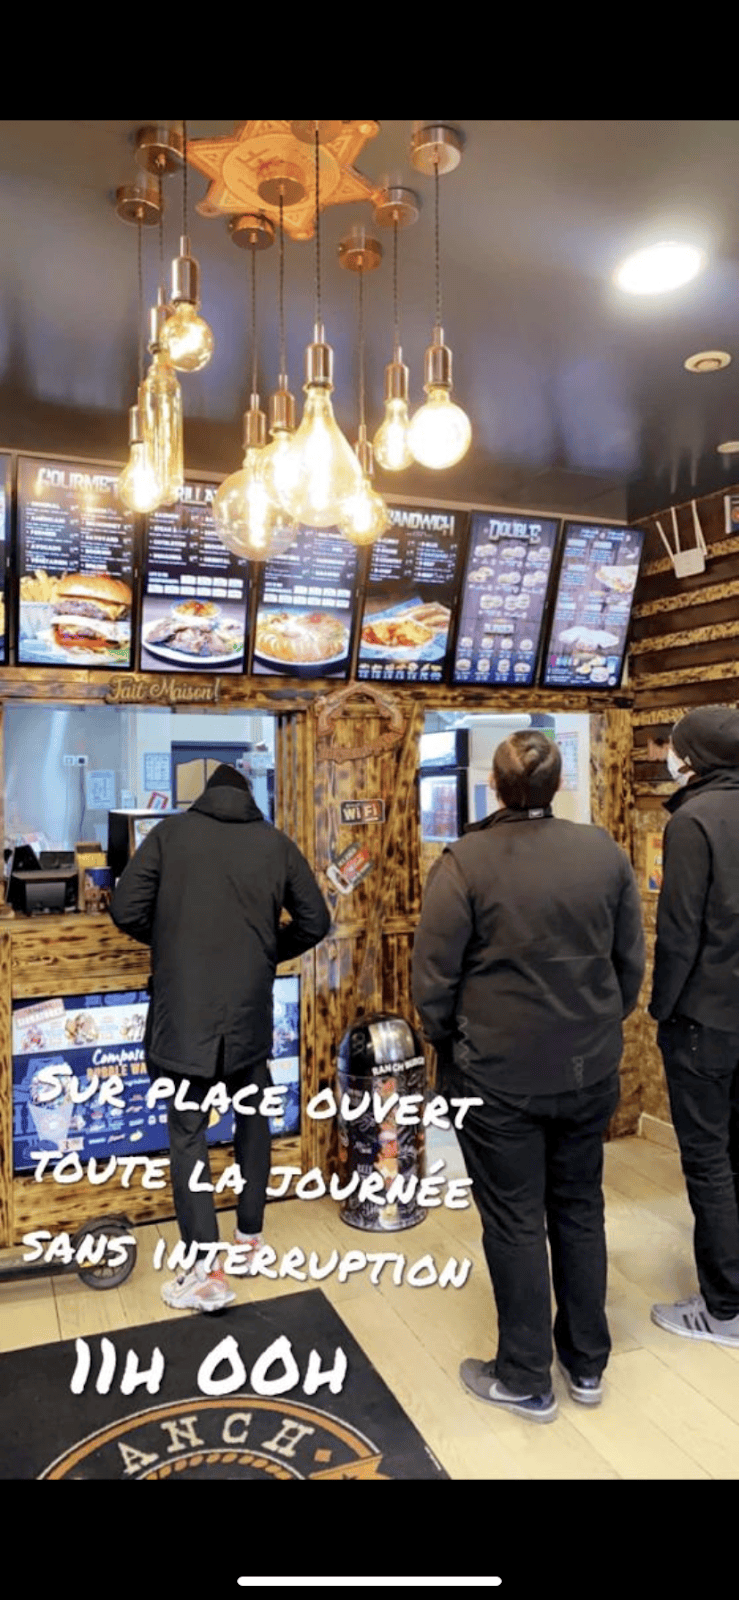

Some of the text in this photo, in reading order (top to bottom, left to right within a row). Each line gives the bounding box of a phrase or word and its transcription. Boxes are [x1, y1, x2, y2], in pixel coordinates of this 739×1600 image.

[488, 519, 542, 545] DOUBLE
[110, 677, 150, 701] Fait
[116, 1411, 315, 1475] ANCH
